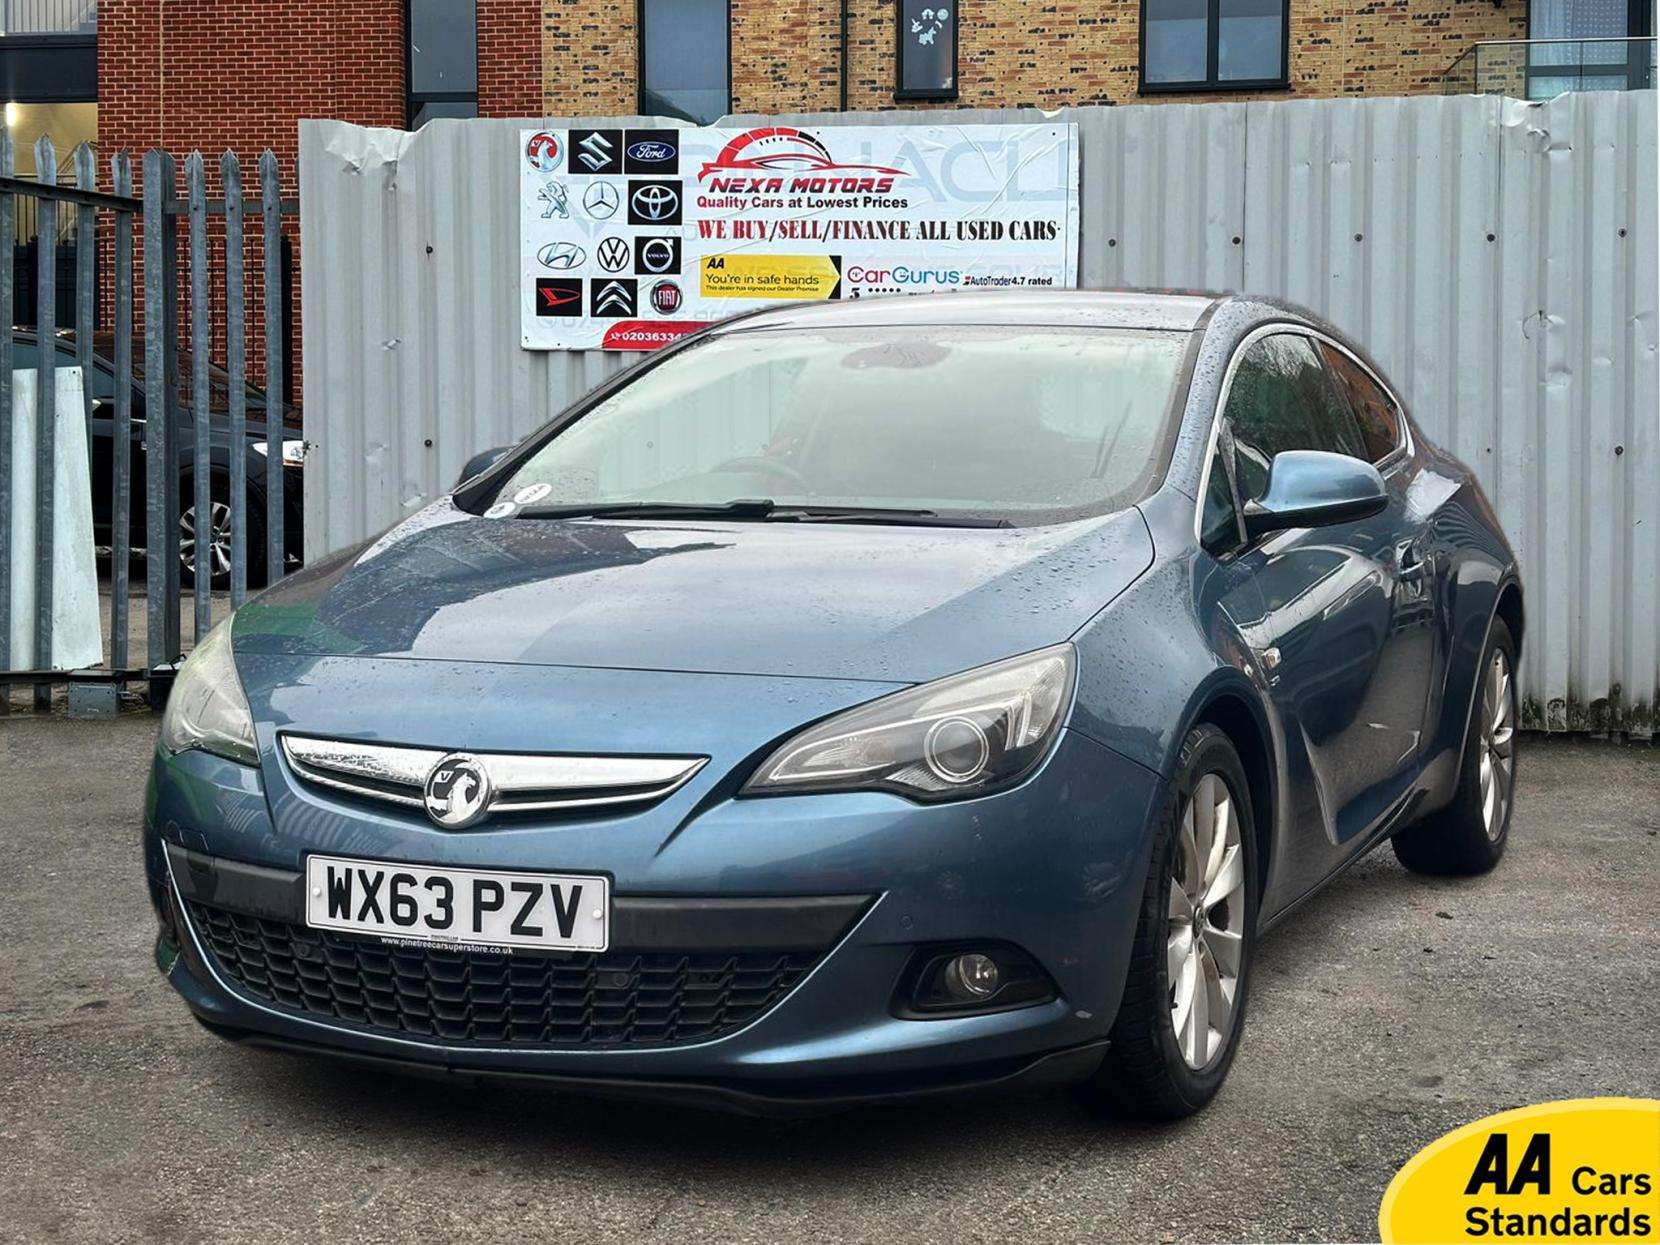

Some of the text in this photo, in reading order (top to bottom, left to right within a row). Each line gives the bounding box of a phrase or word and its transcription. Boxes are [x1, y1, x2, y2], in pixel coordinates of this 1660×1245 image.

[636, 143, 666, 159] Ford
[709, 178, 894, 193] NEXA MOTORS
[697, 196, 908, 210] Quality Cars at Lowest Prices
[697, 220, 727, 240] WE
[916, 220, 951, 240] ALL
[956, 220, 1004, 241] USED
[1009, 220, 1057, 241] CARS
[707, 258, 725, 269] AA
[706, 274, 819, 285] You're in safe hands
[847, 266, 960, 284] CarGurus
[970, 276, 1053, 286] AutoTrader 4.7 rated
[658, 290, 676, 306] FIAT
[327, 866, 583, 938] WX63 PZV
[381, 936, 513, 954] www.pinetreecarsuperstore.co.uk
